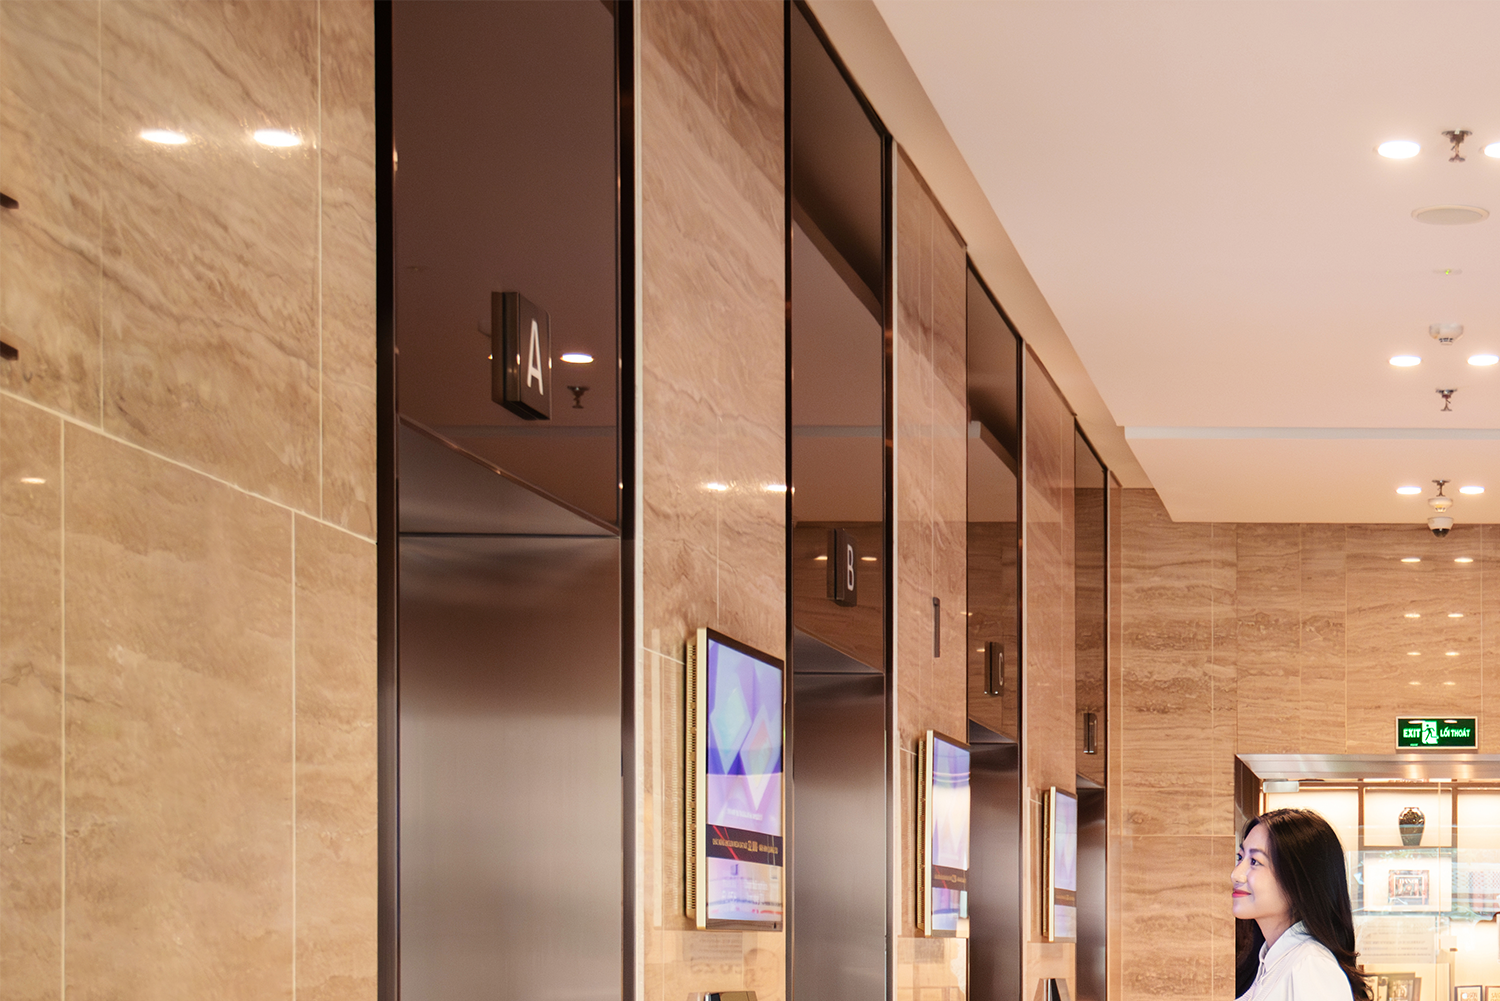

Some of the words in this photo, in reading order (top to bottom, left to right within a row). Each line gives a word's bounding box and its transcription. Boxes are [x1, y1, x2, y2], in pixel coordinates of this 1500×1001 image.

[527, 318, 544, 396] A
[847, 543, 855, 591] B
[1403, 728, 1421, 738] EXIT
[1451, 728, 1470, 738] THOÁT
